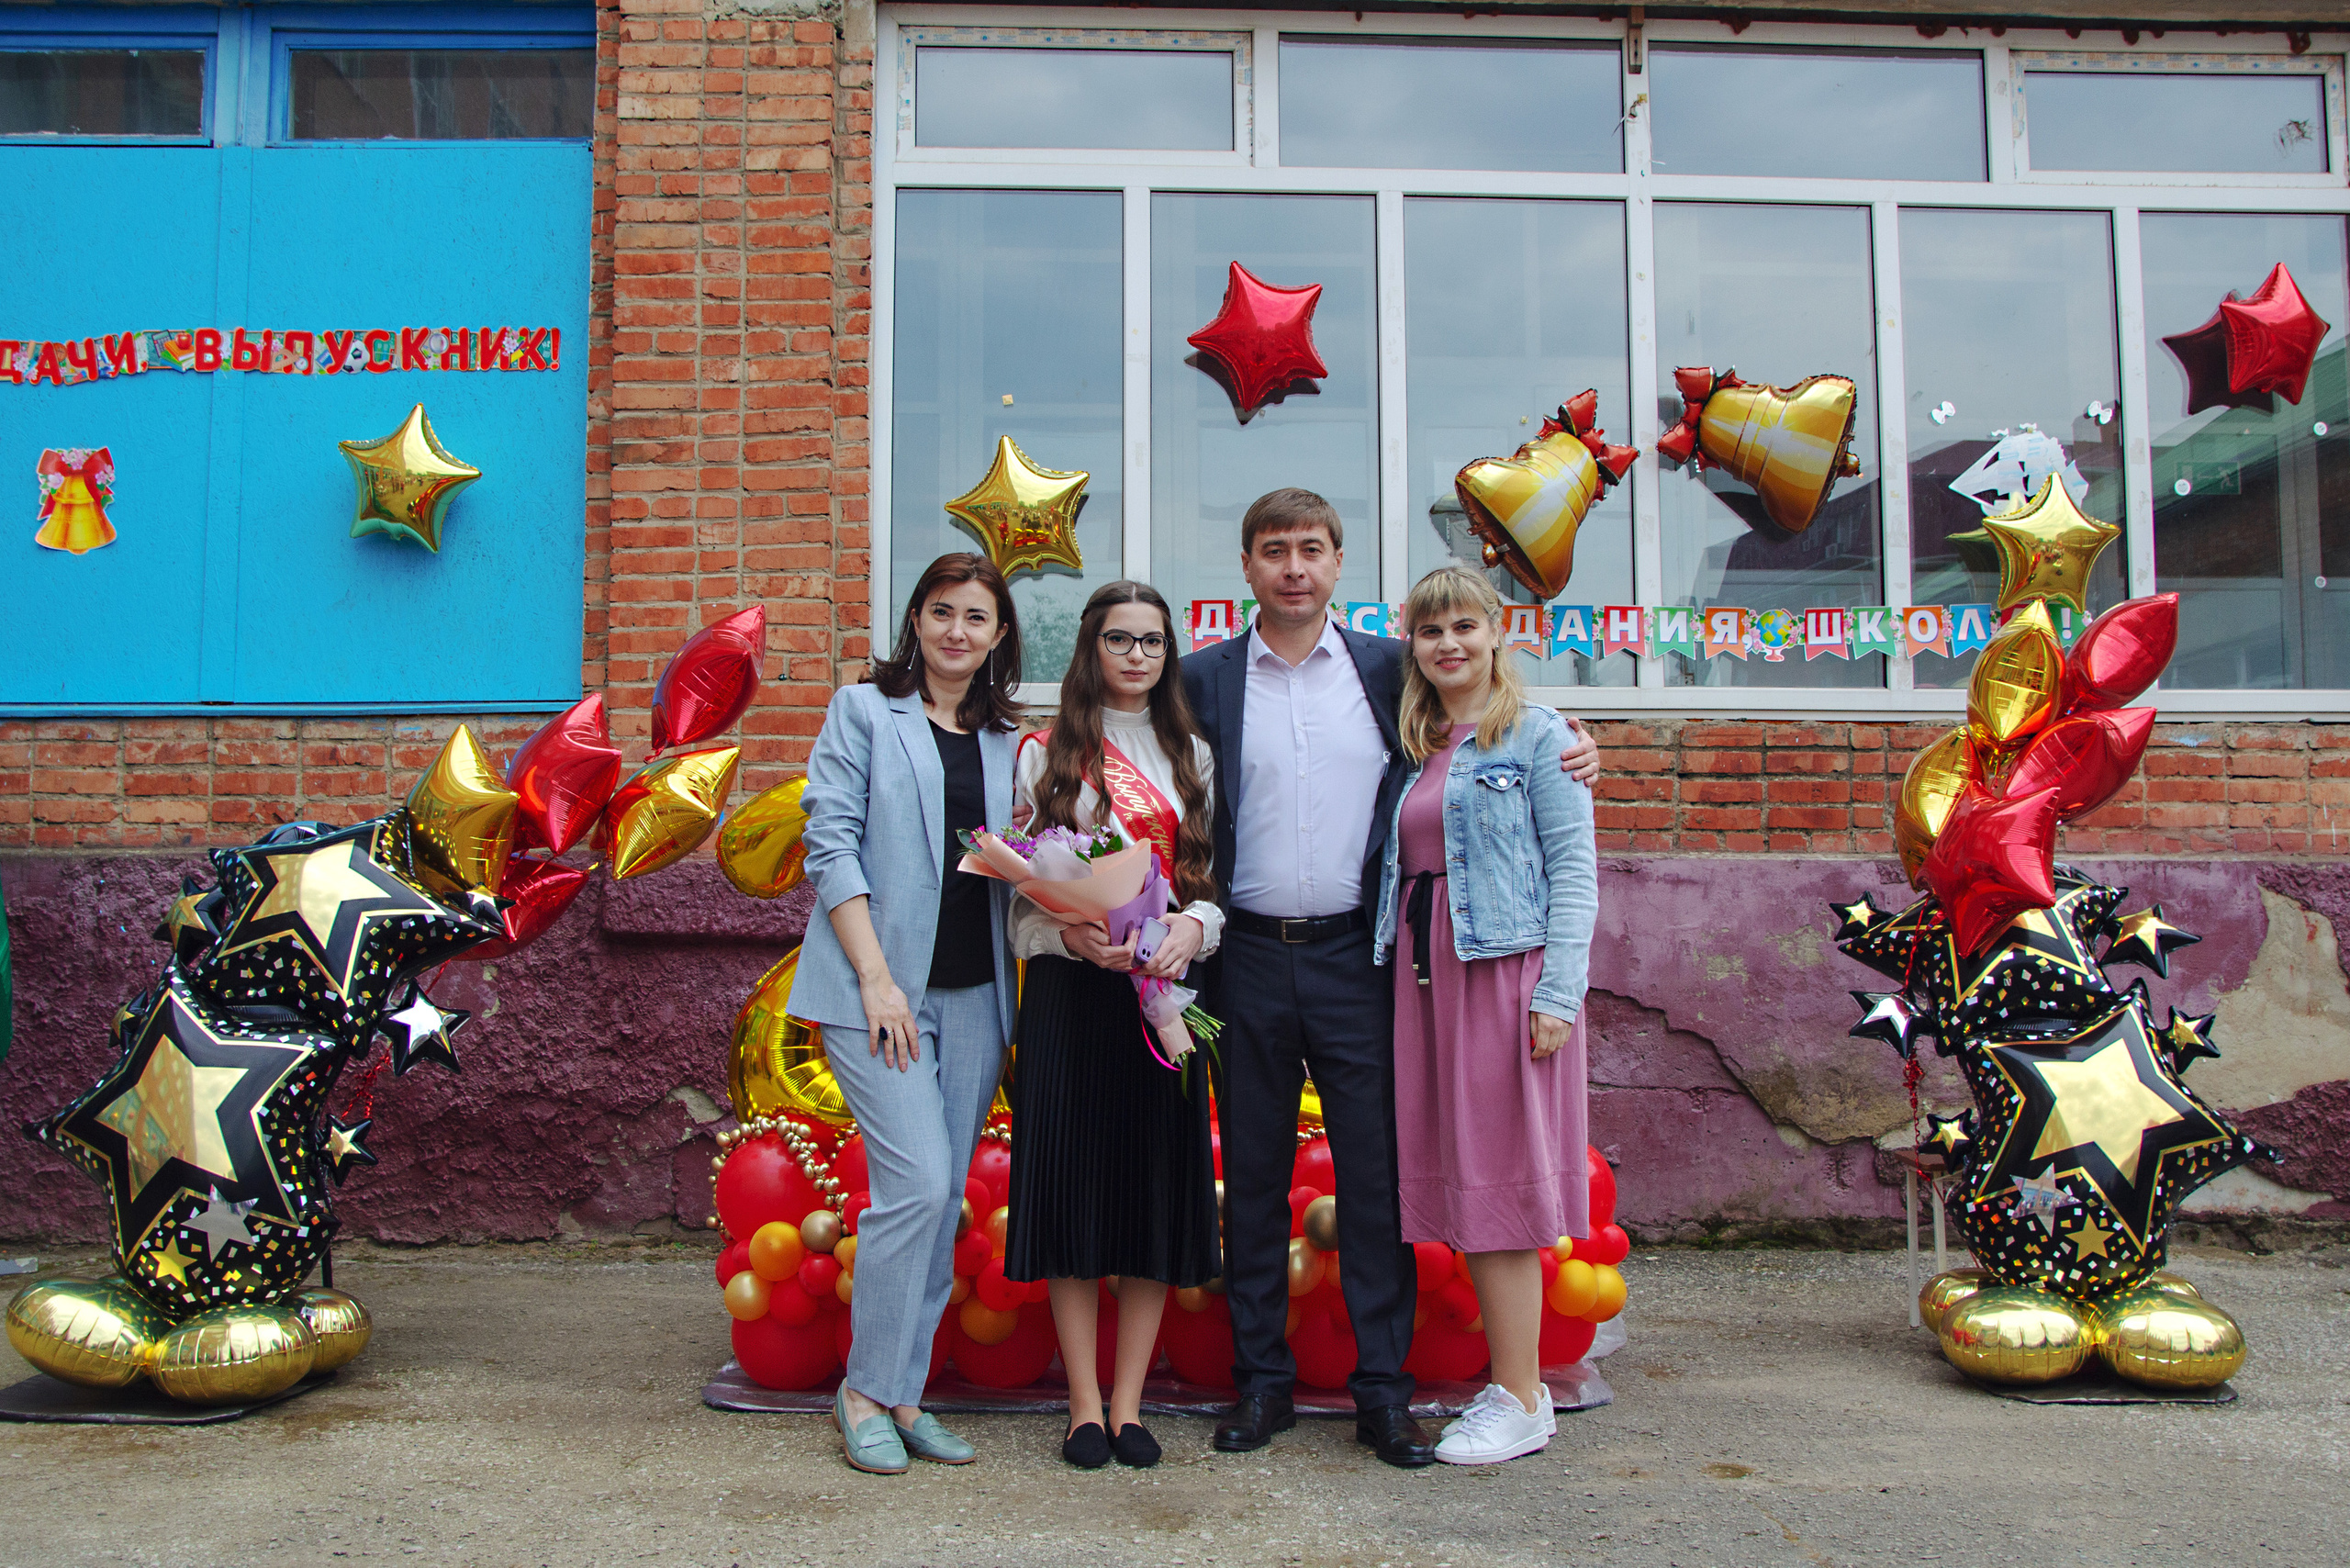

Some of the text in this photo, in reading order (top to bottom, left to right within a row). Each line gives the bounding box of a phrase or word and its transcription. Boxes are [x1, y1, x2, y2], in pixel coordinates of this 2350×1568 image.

[195, 327, 561, 375] ВЫПУСКНИК!
[1351, 606, 1754, 653] СДАНИЯ,
[1806, 608, 2075, 644] ШКОЛ!
